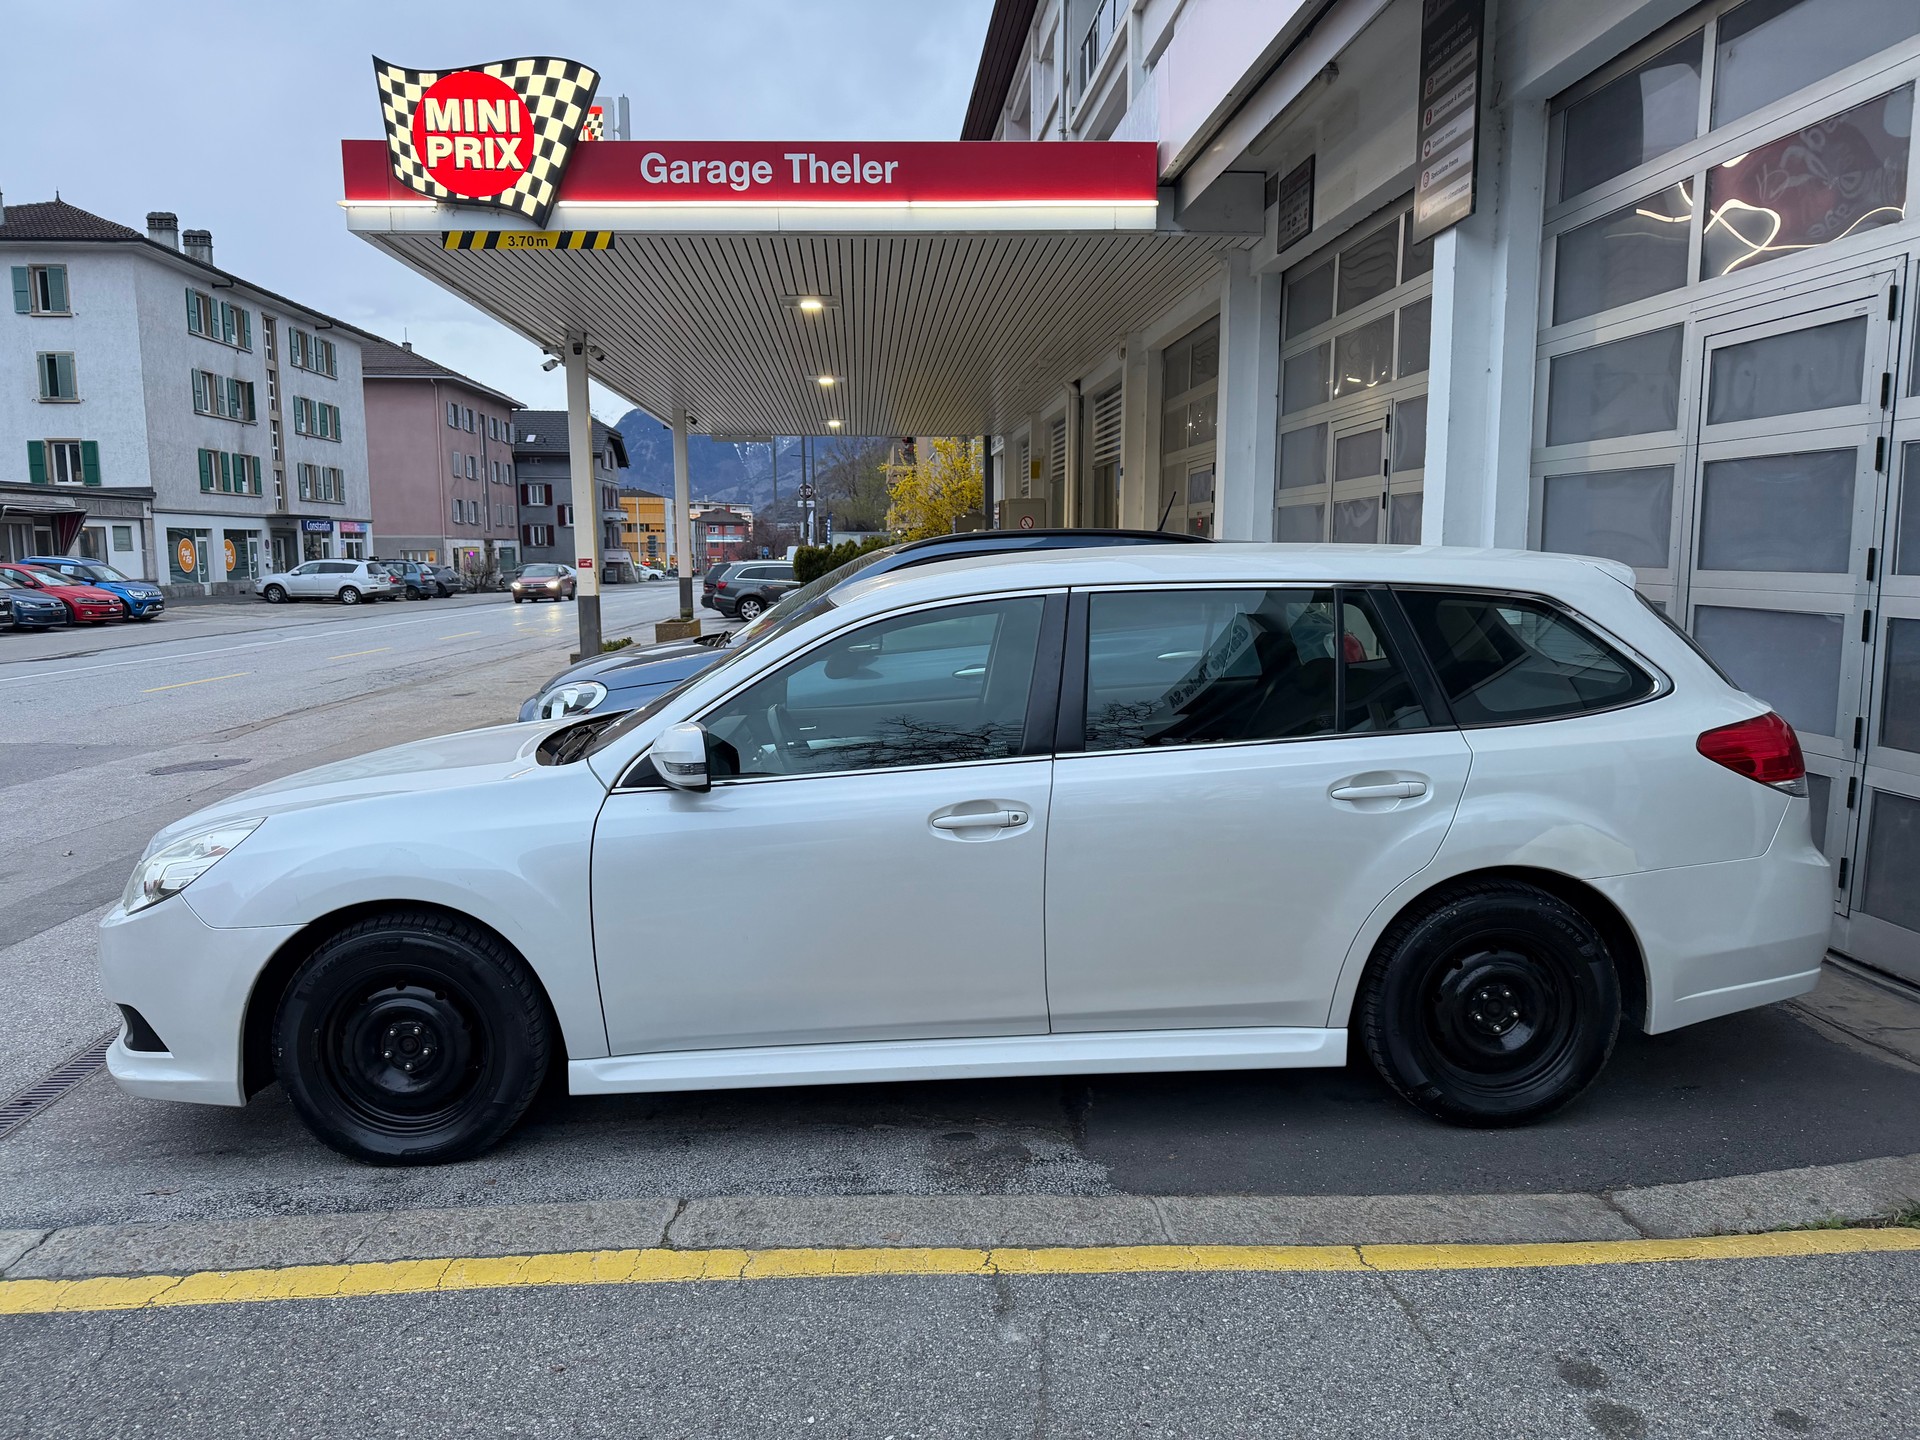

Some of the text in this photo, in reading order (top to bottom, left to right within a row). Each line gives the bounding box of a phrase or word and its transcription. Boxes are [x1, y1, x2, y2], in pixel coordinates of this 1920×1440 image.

[423, 97, 521, 134] MINI
[425, 135, 525, 171] PRIX
[640, 152, 899, 192] Garage Theler
